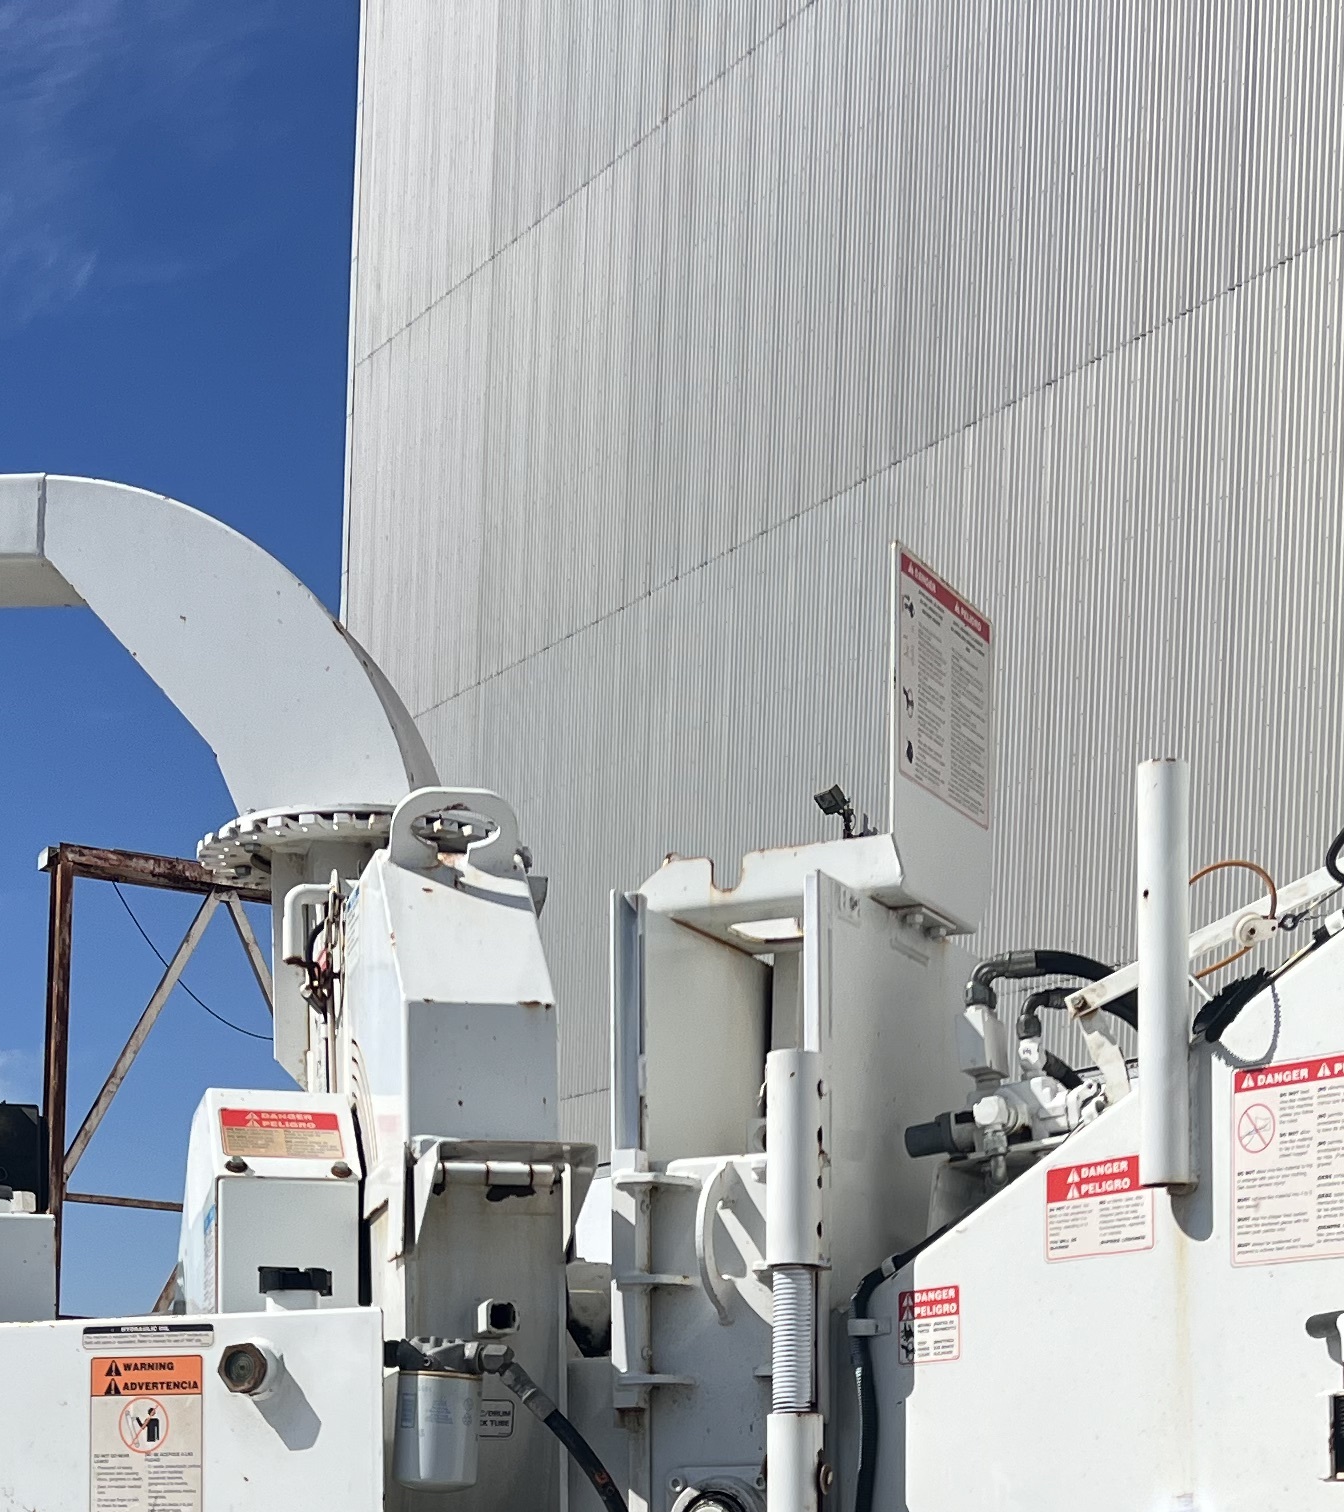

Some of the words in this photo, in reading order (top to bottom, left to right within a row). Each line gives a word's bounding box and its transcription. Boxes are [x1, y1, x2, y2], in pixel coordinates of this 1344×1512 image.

[1257, 1068, 1309, 1086] DANGER
[260, 1112, 313, 1121] DANGER
[261, 1120, 316, 1129] PELIGRO
[1081, 1160, 1129, 1179] DANGER
[1080, 1178, 1131, 1196] PELIGRO
[914, 1288, 956, 1303] DANGER
[914, 1302, 957, 1317] PELIGRO
[123, 1362, 175, 1371] WARNING
[122, 1380, 199, 1391] ADVERTENCIA
